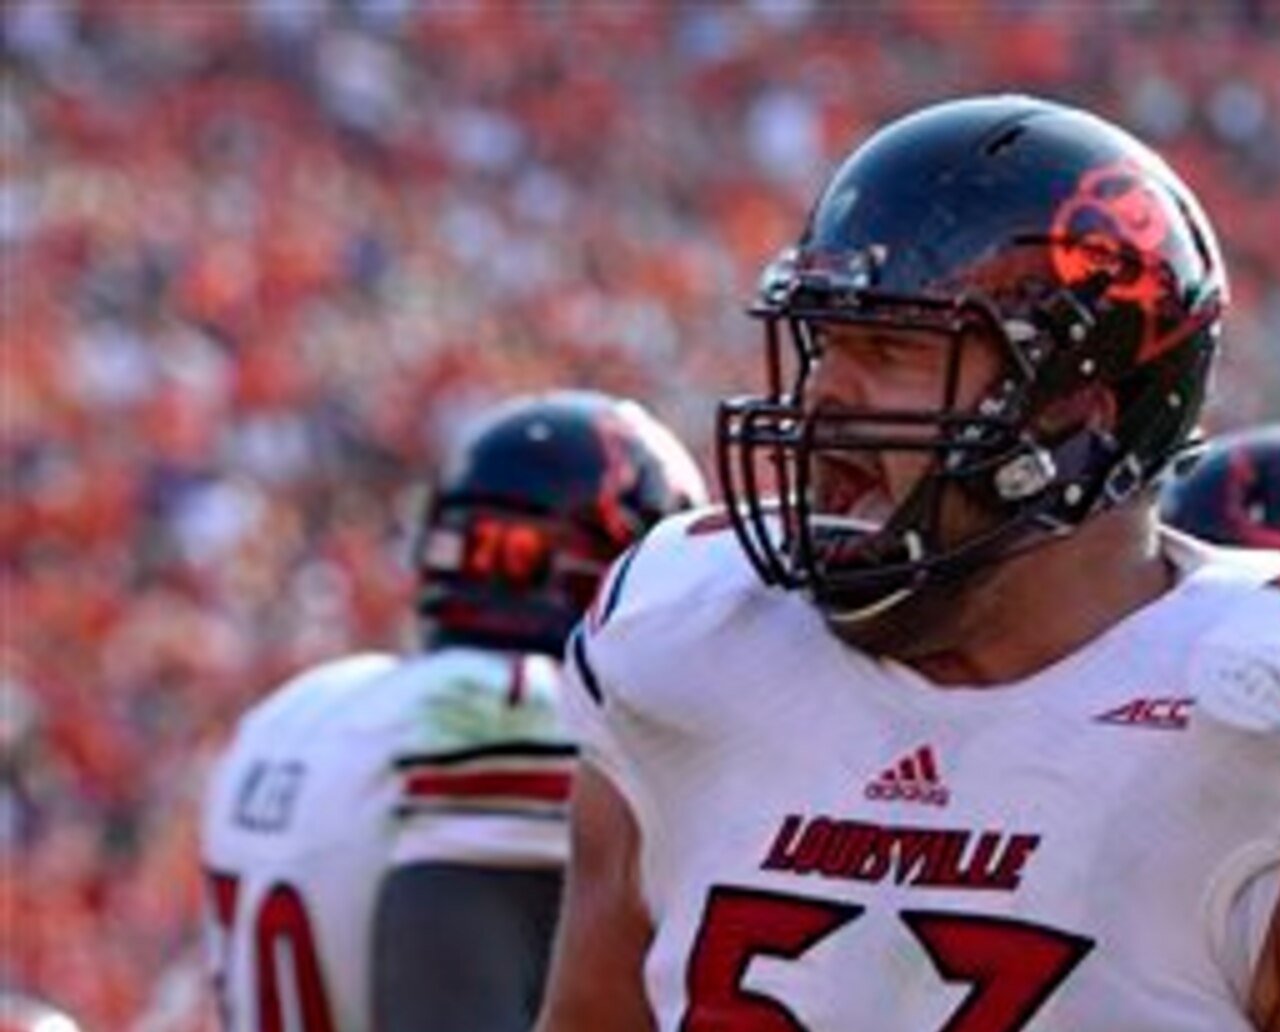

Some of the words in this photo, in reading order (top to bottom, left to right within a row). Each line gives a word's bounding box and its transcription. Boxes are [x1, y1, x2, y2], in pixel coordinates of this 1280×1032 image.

[1092, 698, 1197, 730] ACC
[864, 783, 950, 808] adidas
[759, 814, 1041, 891] LOUISVILLE
